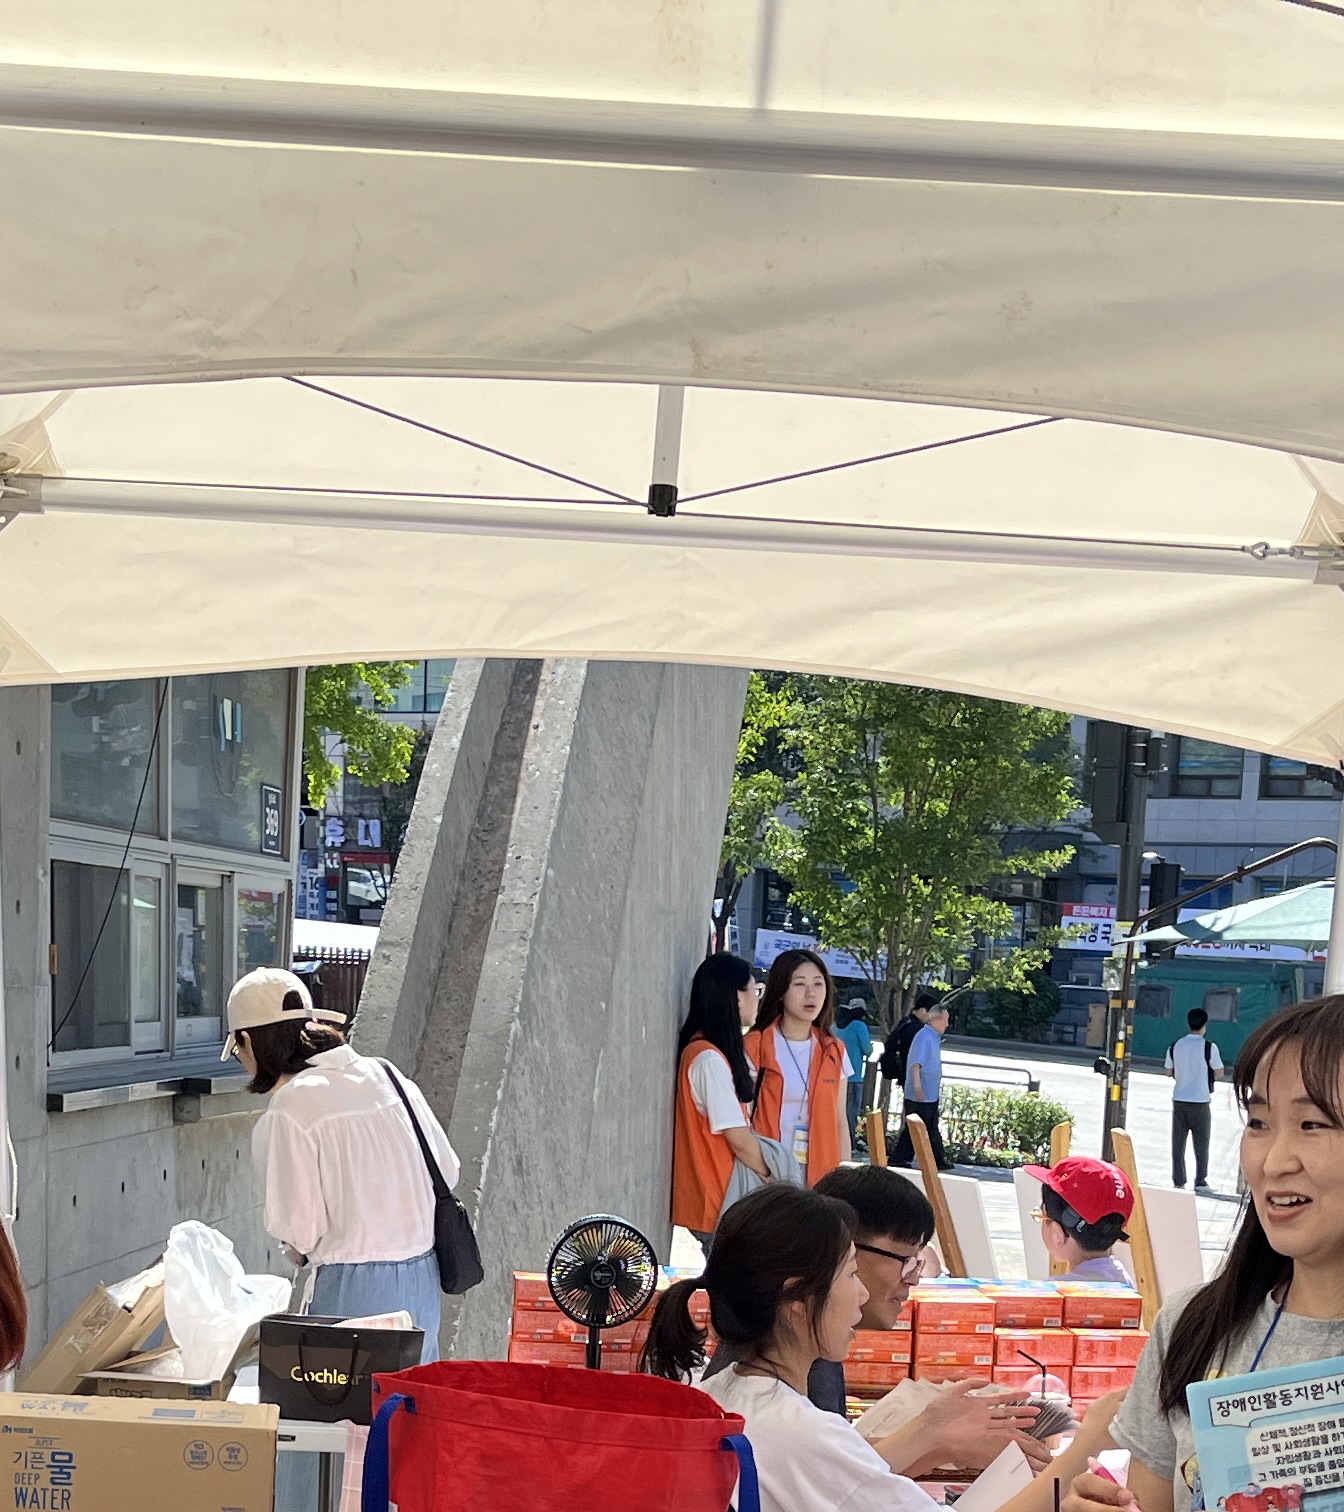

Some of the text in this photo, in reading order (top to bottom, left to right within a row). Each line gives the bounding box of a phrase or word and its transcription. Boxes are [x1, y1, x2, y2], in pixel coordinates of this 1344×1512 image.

[325, 817, 382, 848] 휴대
[290, 1365, 362, 1386] Cochler
[14, 1472, 40, 1485] DEEP
[45, 1450, 77, 1487] 물
[13, 1487, 71, 1511] WATER
